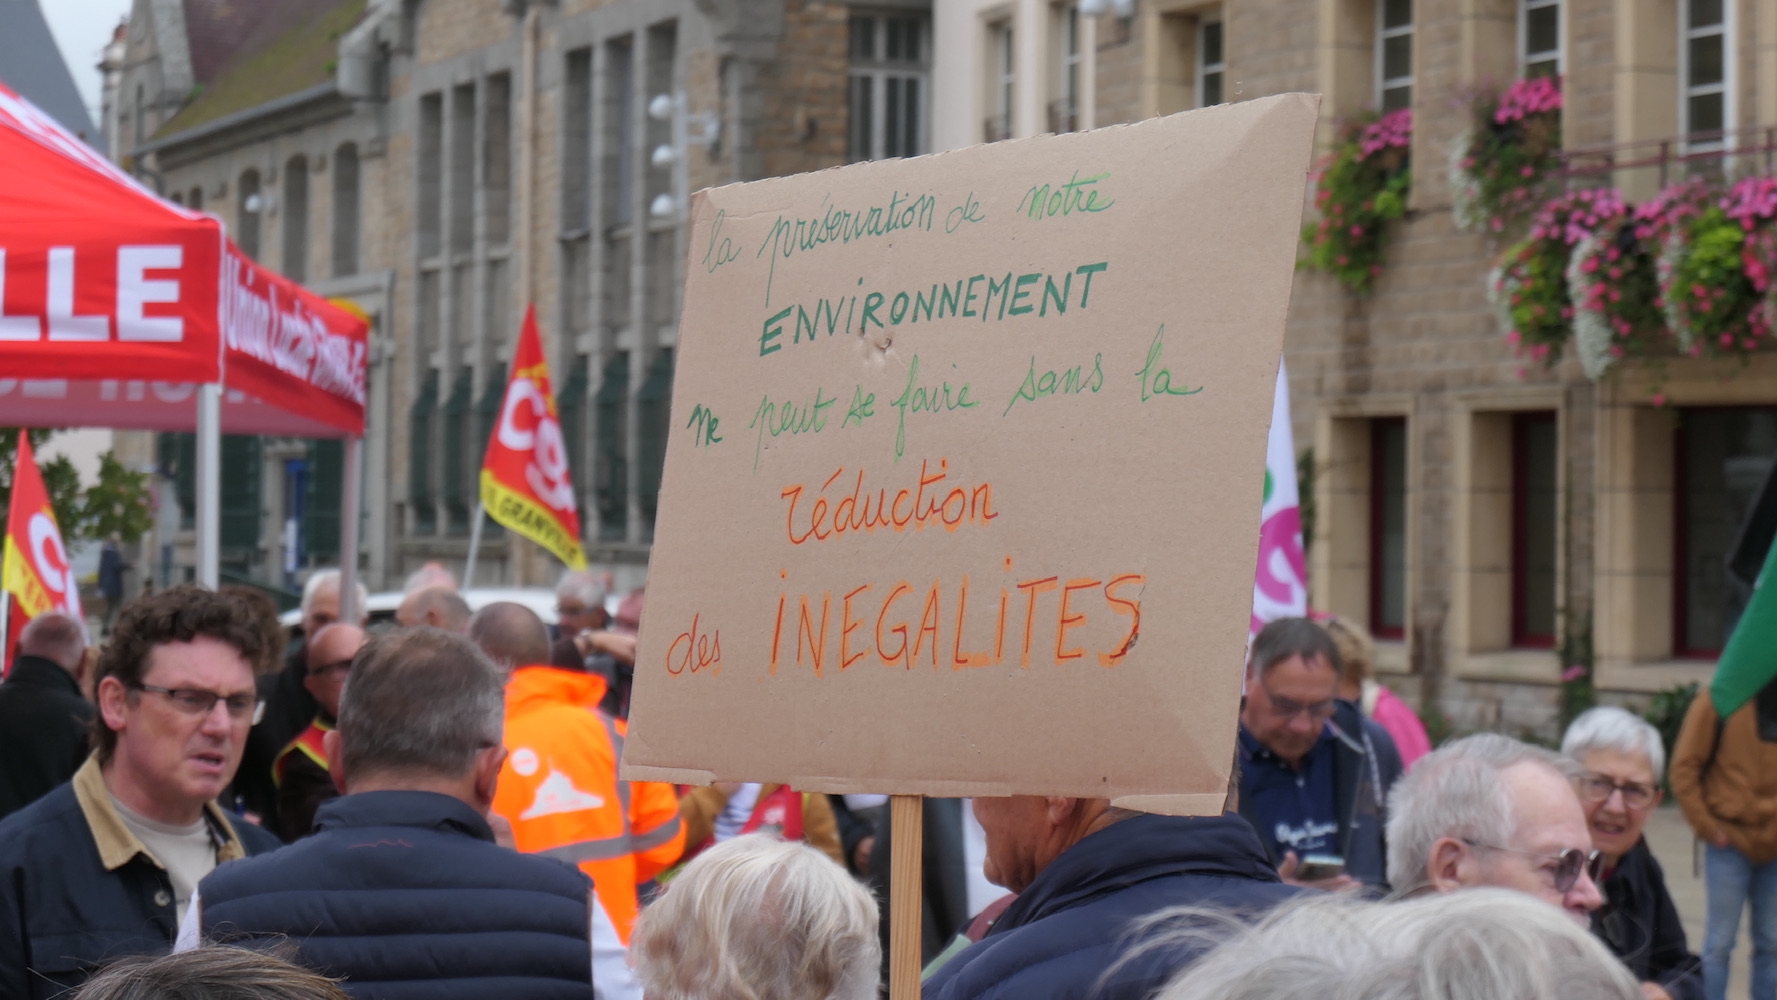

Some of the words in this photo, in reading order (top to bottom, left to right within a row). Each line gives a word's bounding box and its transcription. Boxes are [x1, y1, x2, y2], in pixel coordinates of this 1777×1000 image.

[704, 209, 742, 273] la
[757, 192, 936, 309] préservation
[945, 193, 986, 234] de
[1017, 170, 1116, 221] notre
[748, 387, 837, 473] peut
[842, 384, 876, 428] se
[891, 354, 979, 464] faire
[1003, 352, 1105, 416] sans
[1135, 322, 1204, 402] la
[782, 458, 999, 545] réduction
[666, 613, 722, 677] des
